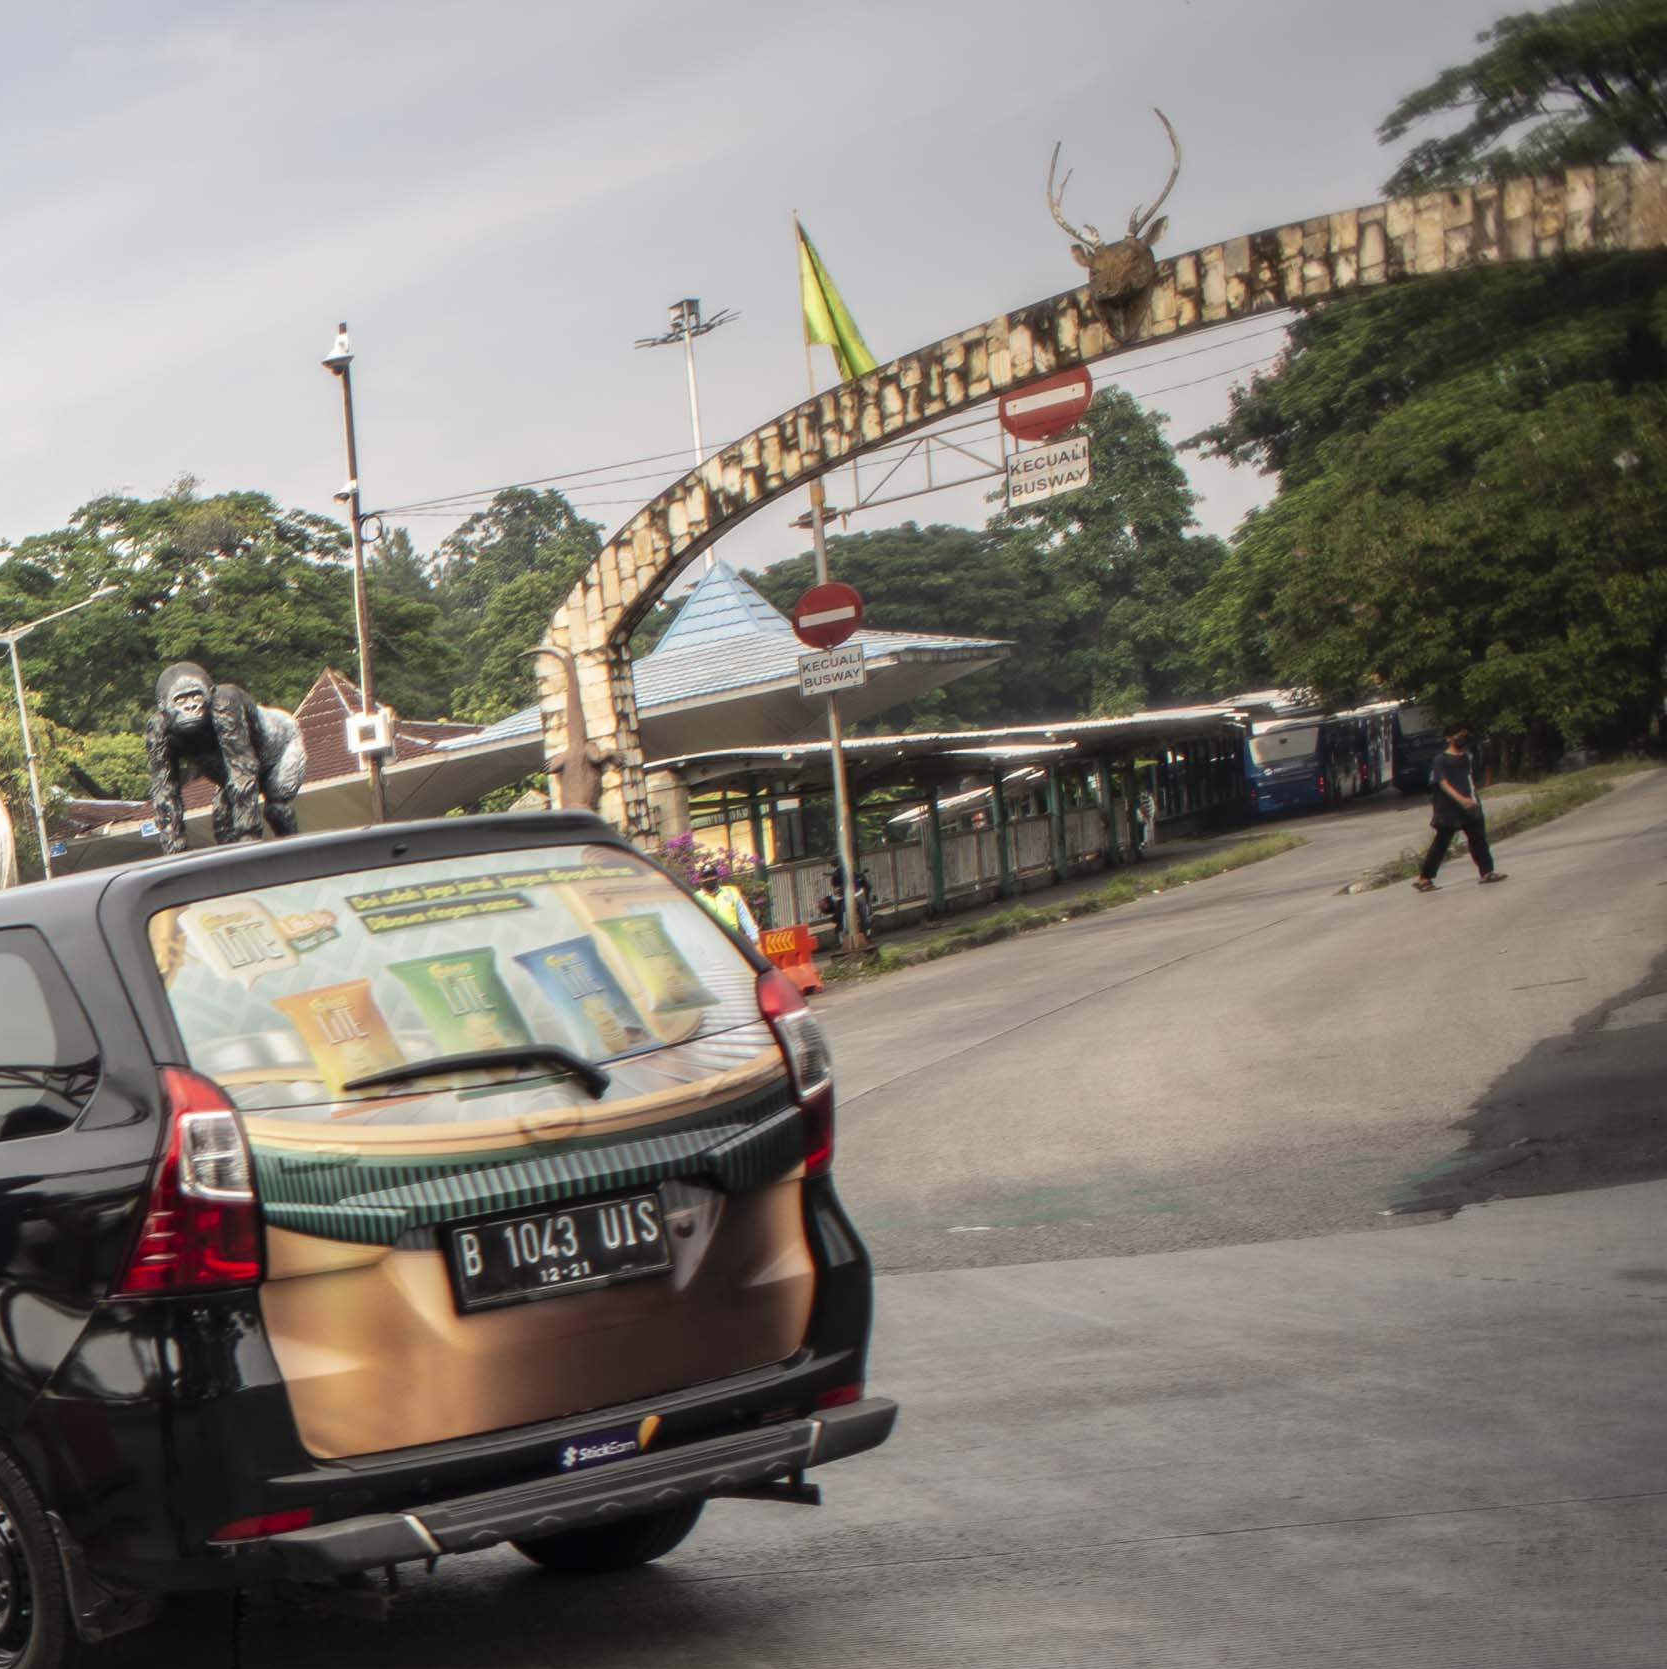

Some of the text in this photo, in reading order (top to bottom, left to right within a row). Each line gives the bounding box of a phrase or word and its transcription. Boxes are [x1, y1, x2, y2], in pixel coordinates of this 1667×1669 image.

[1010, 445, 1088, 476] KECUALI
[1011, 466, 1089, 498] BUSWAY
[802, 652, 862, 674] KECUALI
[803, 667, 861, 689] BUSWAY
[460, 1200, 659, 1277] B 1043 UIS
[540, 1260, 591, 1283] 12-21
[578, 1440, 636, 1461] StickEarn
